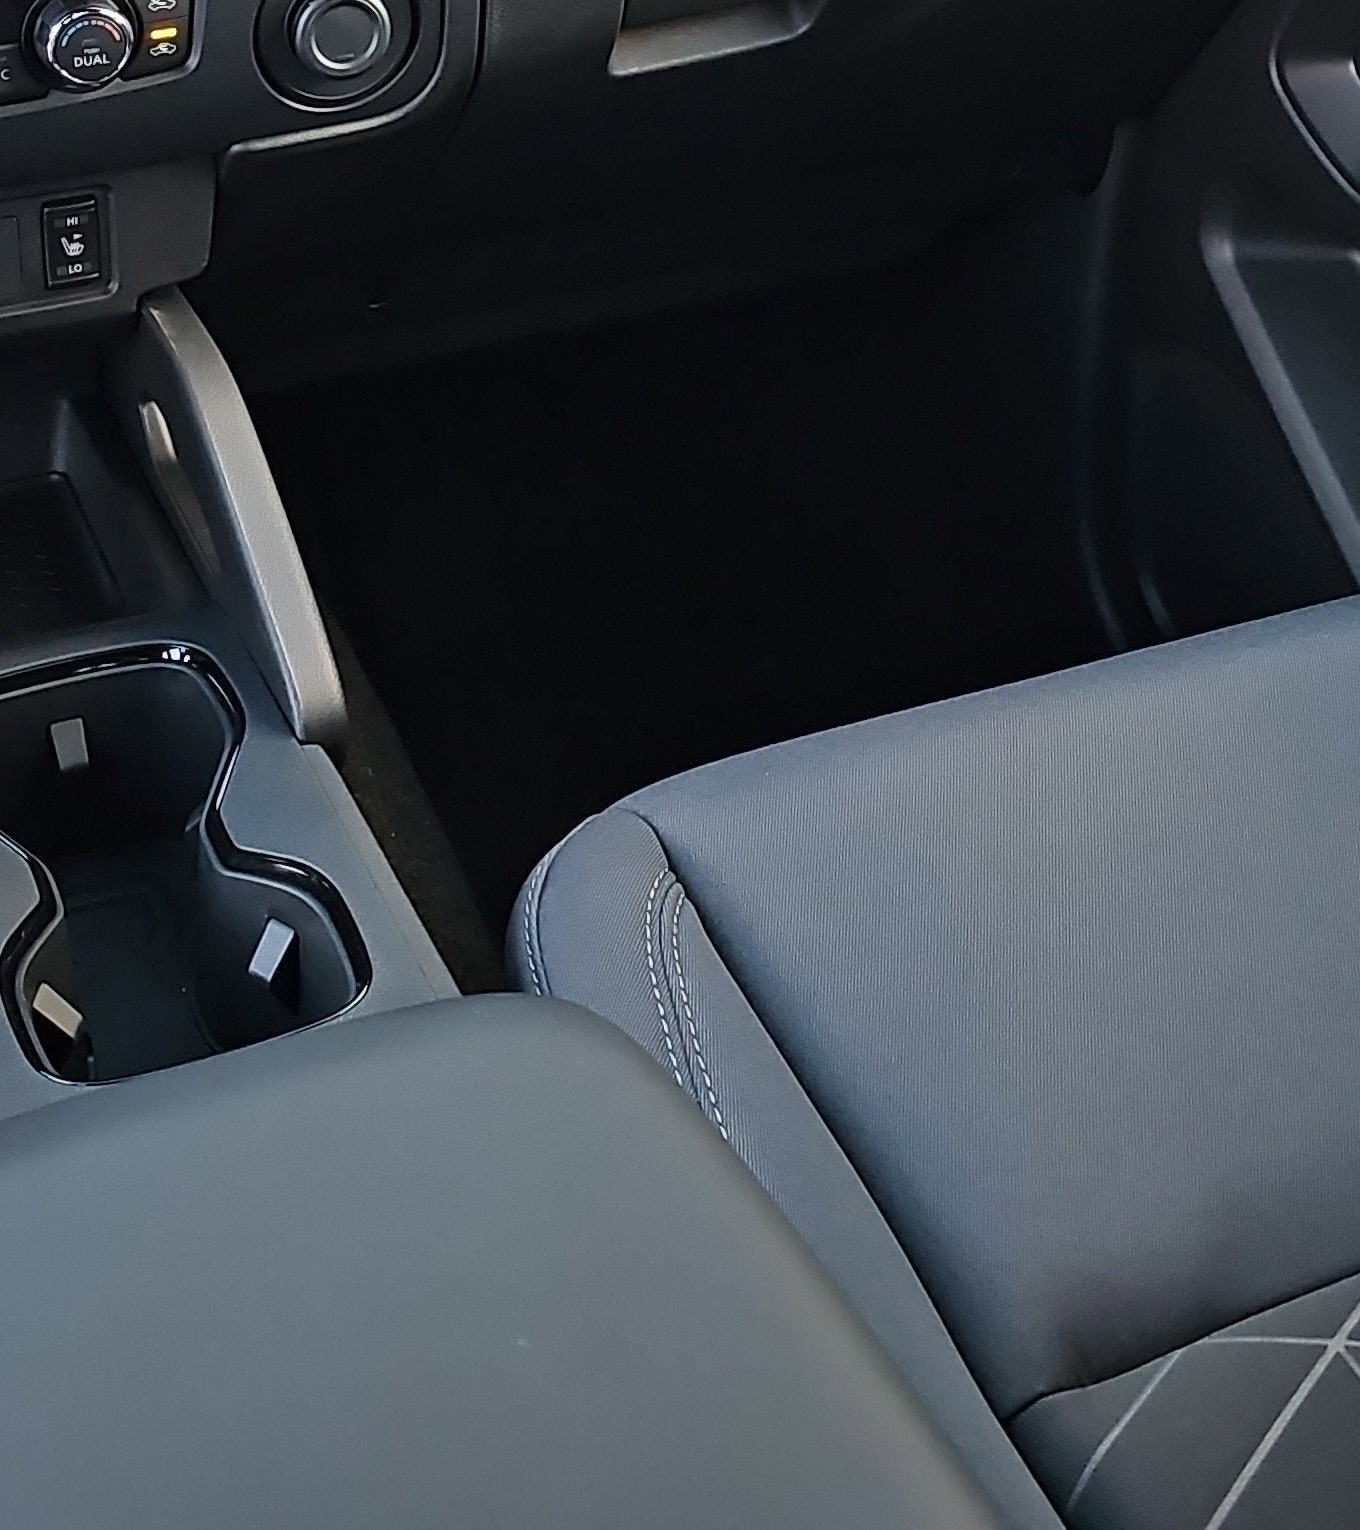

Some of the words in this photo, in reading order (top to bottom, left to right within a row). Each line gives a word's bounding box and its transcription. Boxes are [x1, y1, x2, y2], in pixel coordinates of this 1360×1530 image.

[73, 52, 111, 68] DUAL
[66, 216, 79, 227] HI
[68, 263, 83, 275] LO
